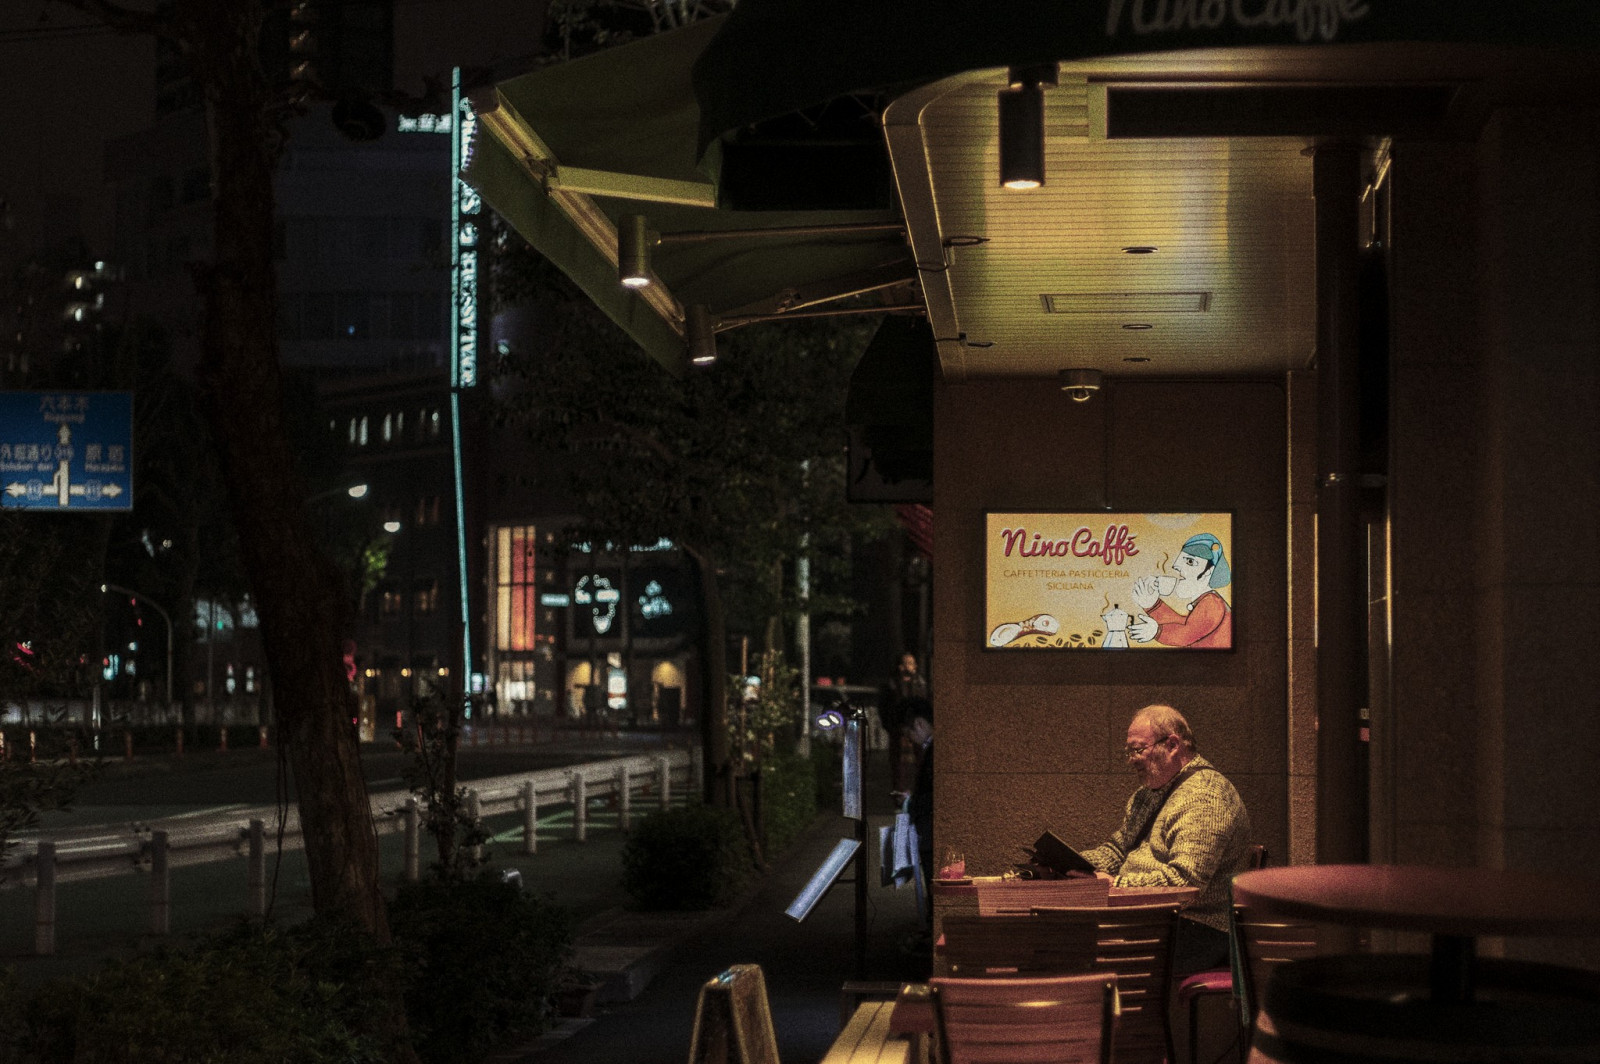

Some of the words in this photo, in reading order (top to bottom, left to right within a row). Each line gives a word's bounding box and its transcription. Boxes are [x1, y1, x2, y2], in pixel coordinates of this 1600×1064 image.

[460, 331, 477, 388] ROYAL
[1003, 569, 1066, 578] CAFFETTERIA
[1069, 569, 1130, 578] PASTICCERIA
[1046, 581, 1094, 591] SICILIANA
